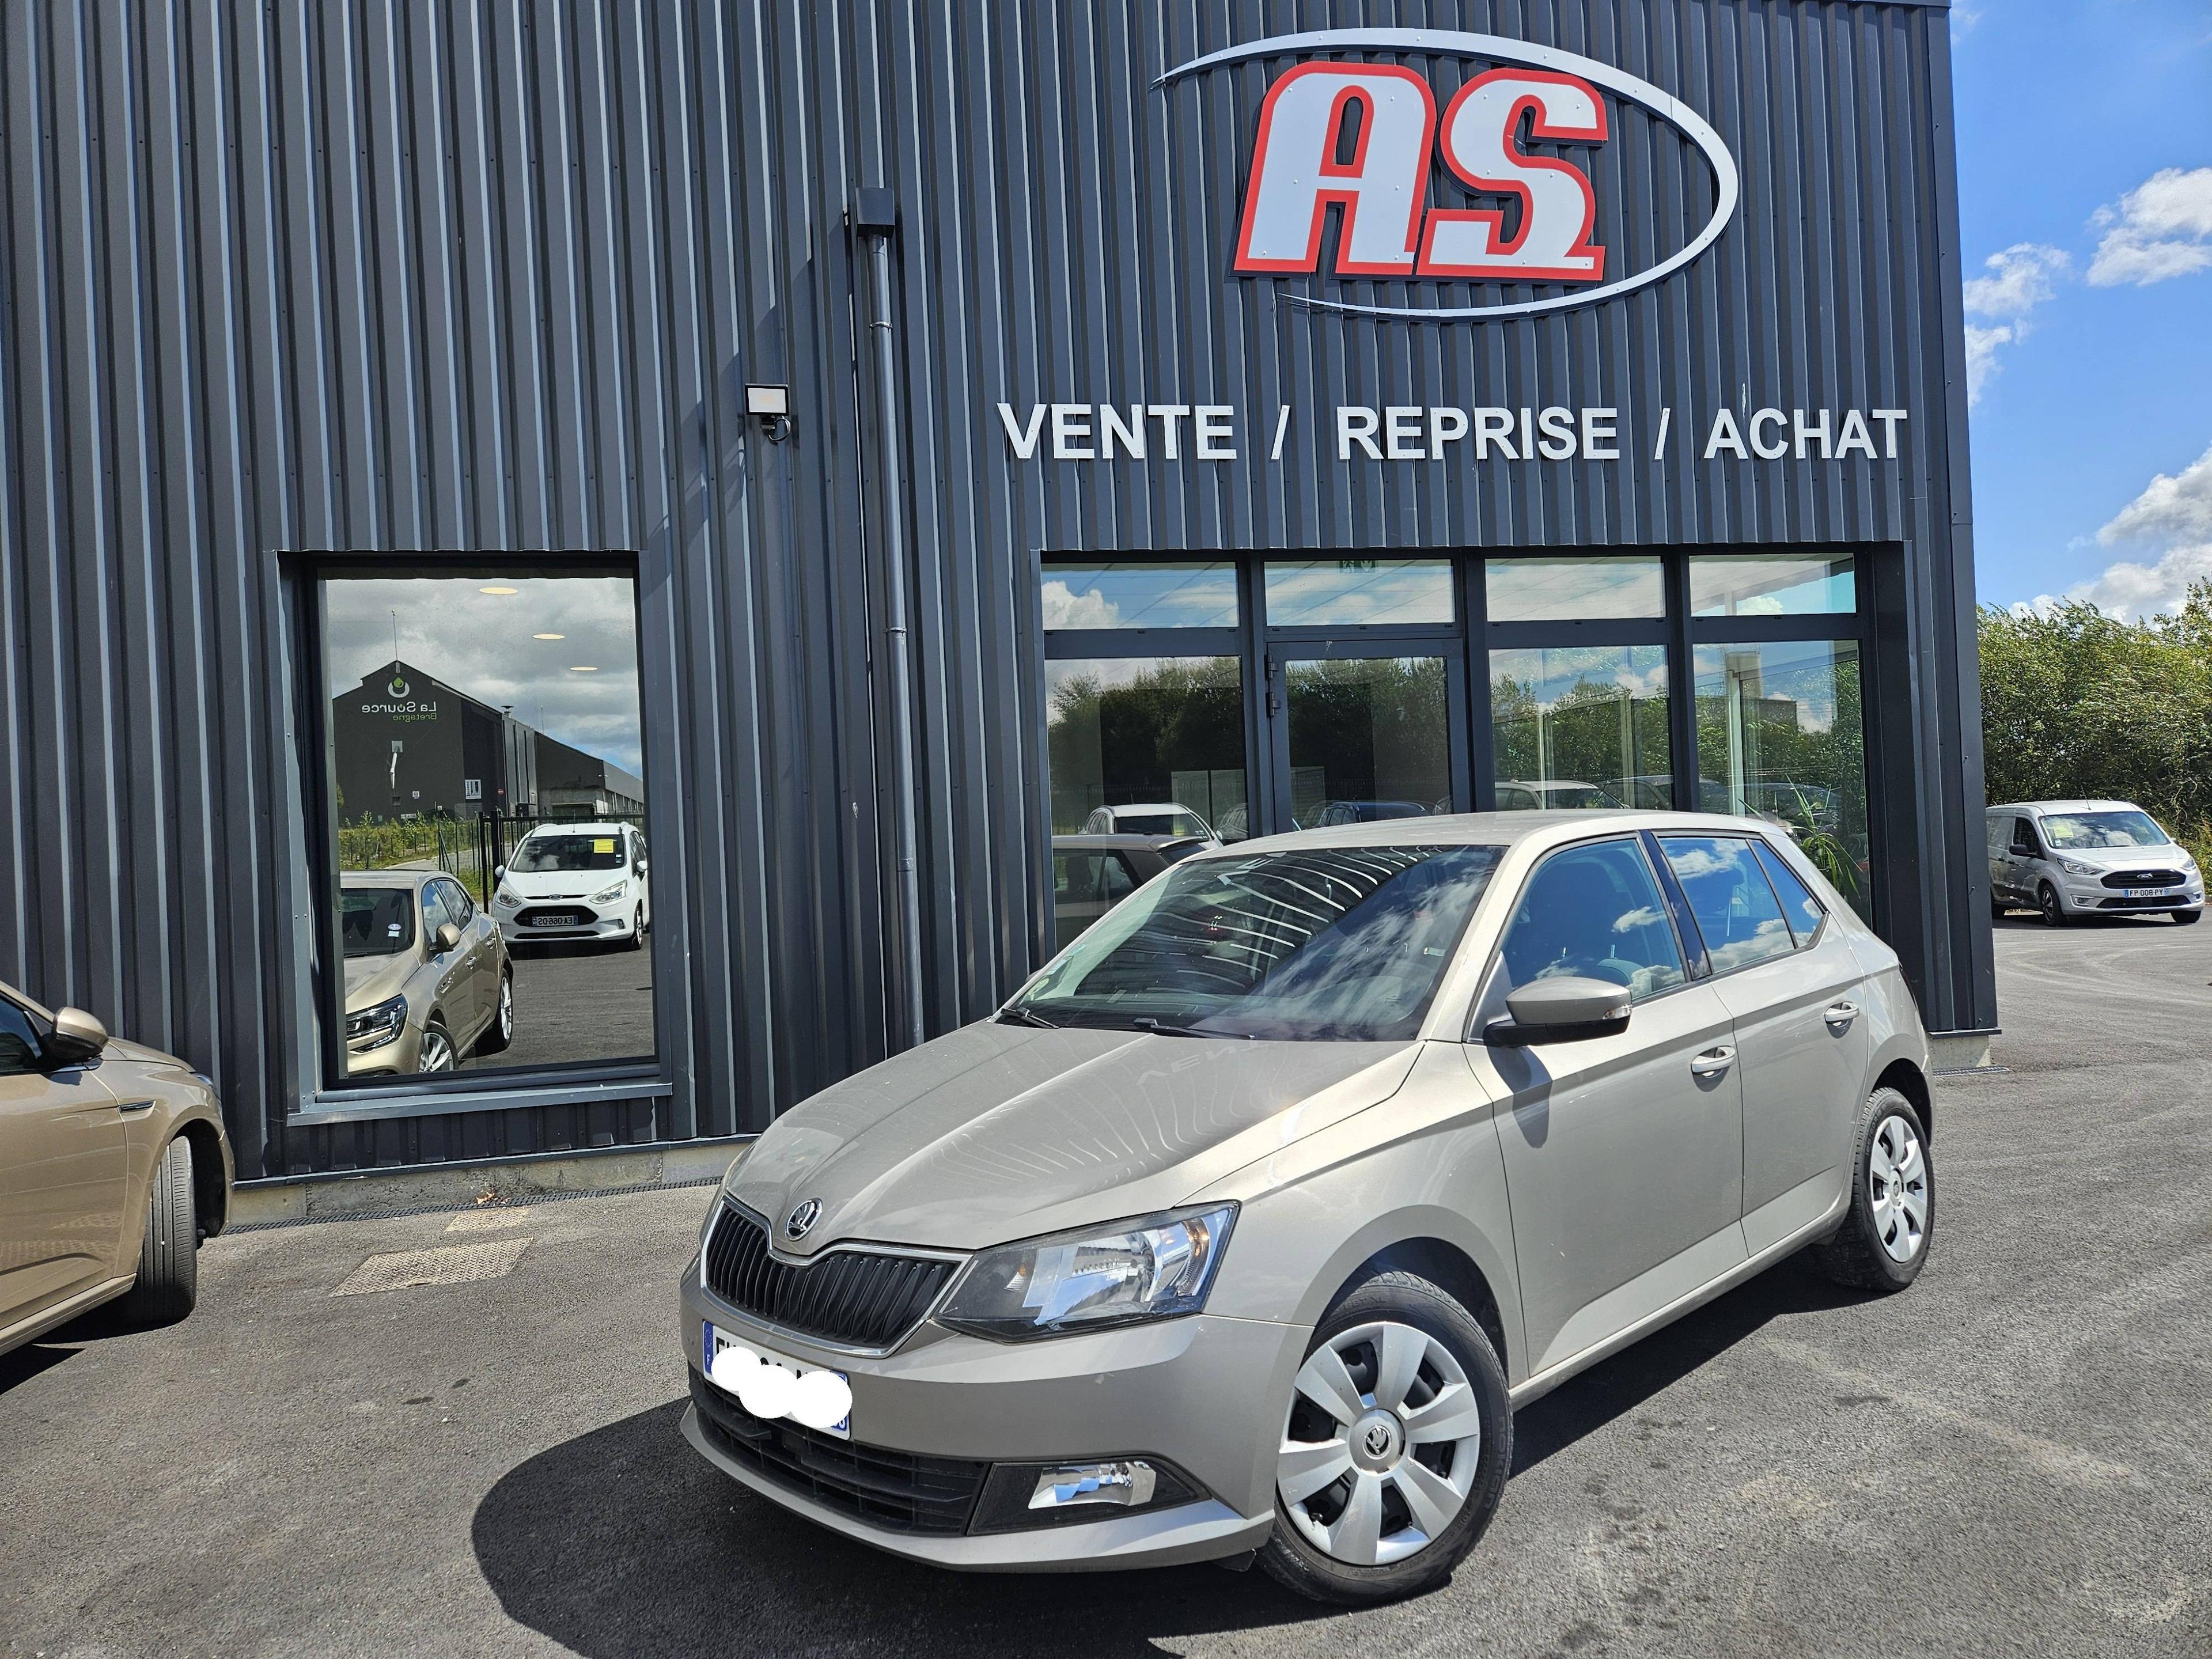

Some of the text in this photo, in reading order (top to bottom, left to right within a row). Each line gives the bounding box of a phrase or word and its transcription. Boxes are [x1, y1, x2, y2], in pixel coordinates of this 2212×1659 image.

[1234, 60, 1608, 281] AS
[997, 403, 1907, 460] VENTE / REPRISE / ACHAT
